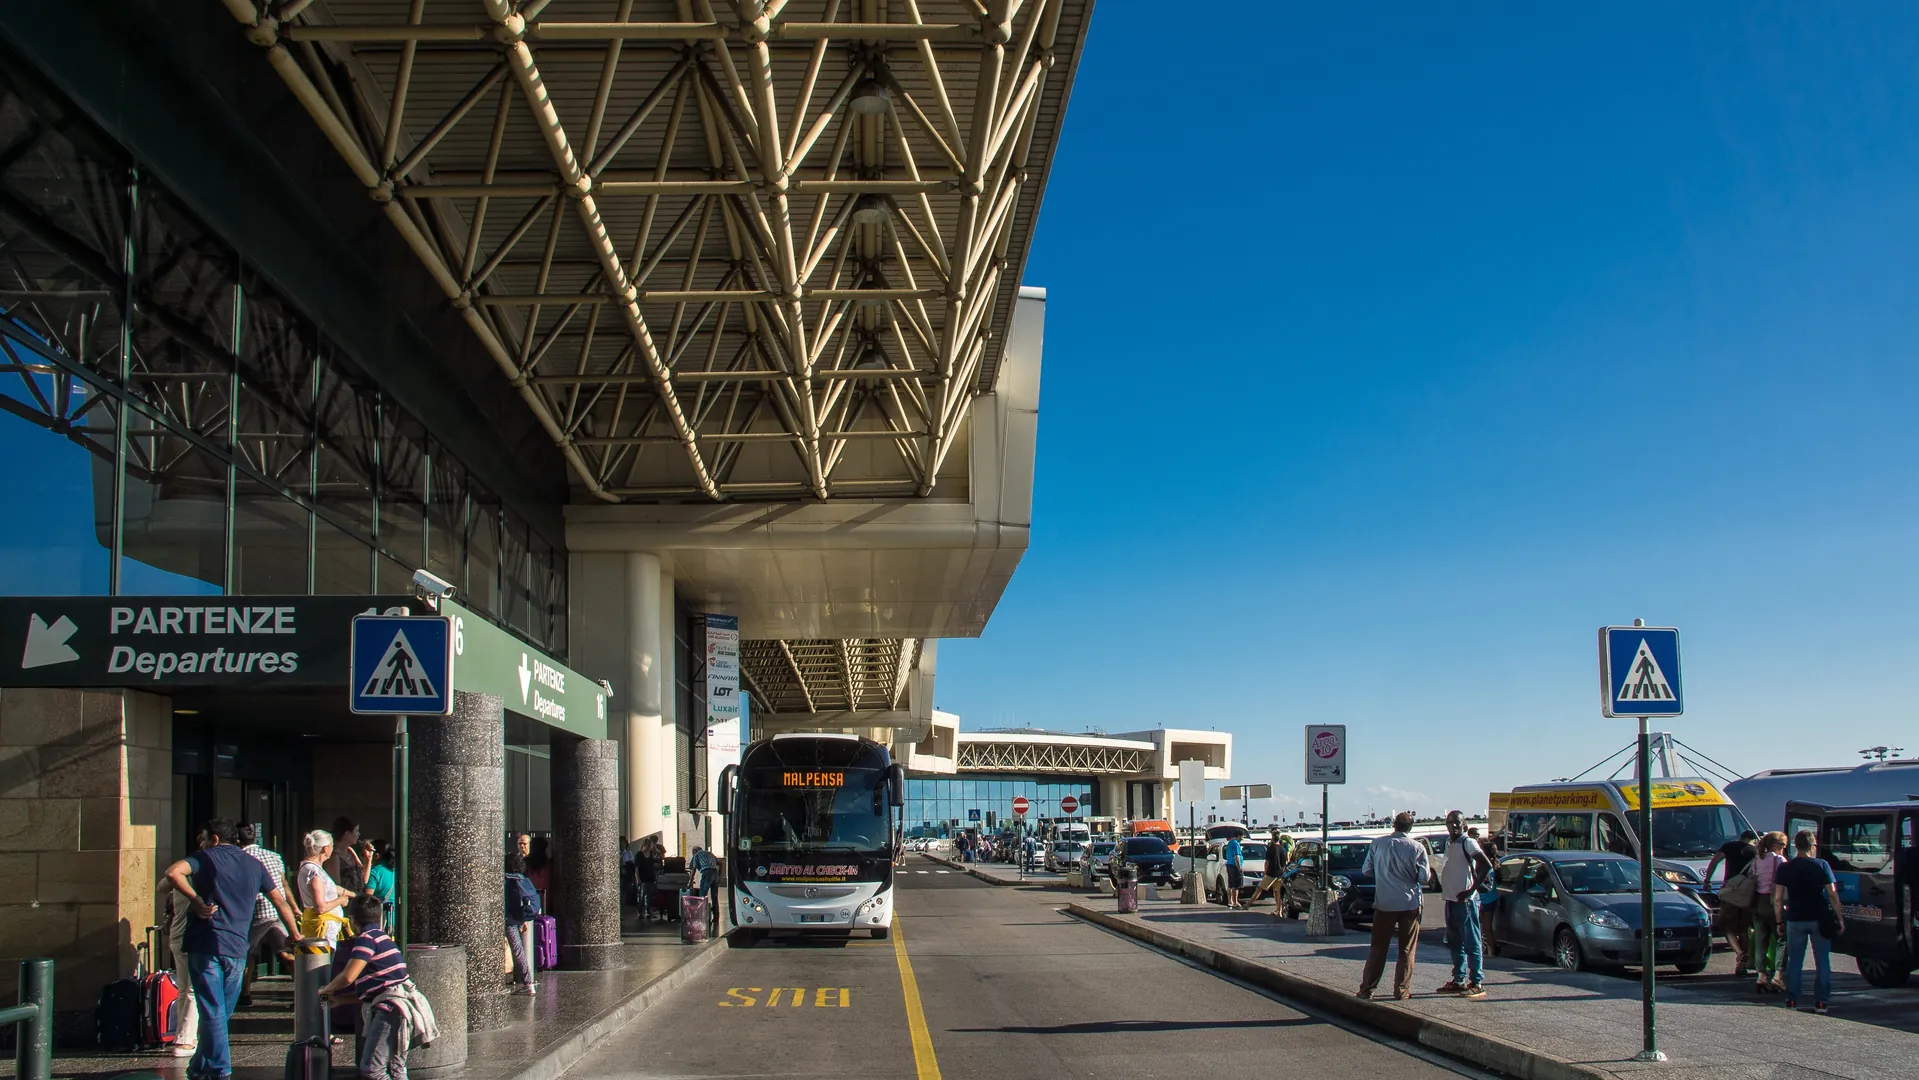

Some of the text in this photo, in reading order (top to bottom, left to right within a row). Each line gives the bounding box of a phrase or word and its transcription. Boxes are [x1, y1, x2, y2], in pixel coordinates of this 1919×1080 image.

[110, 606, 296, 634] PARTENZE
[108, 645, 299, 680] Departures
[533, 659, 565, 694] PARTENZE
[708, 673, 738, 681] FINNAIR
[713, 686, 733, 696] LOT
[533, 689, 566, 721] Departures
[596, 692, 604, 720] 16
[713, 704, 739, 712] Luxair
[783, 772, 844, 786] MALPENSA
[1510, 791, 1598, 807] www.planetparking.it
[803, 865, 816, 875] AL
[816, 865, 859, 876] CHECK-IN
